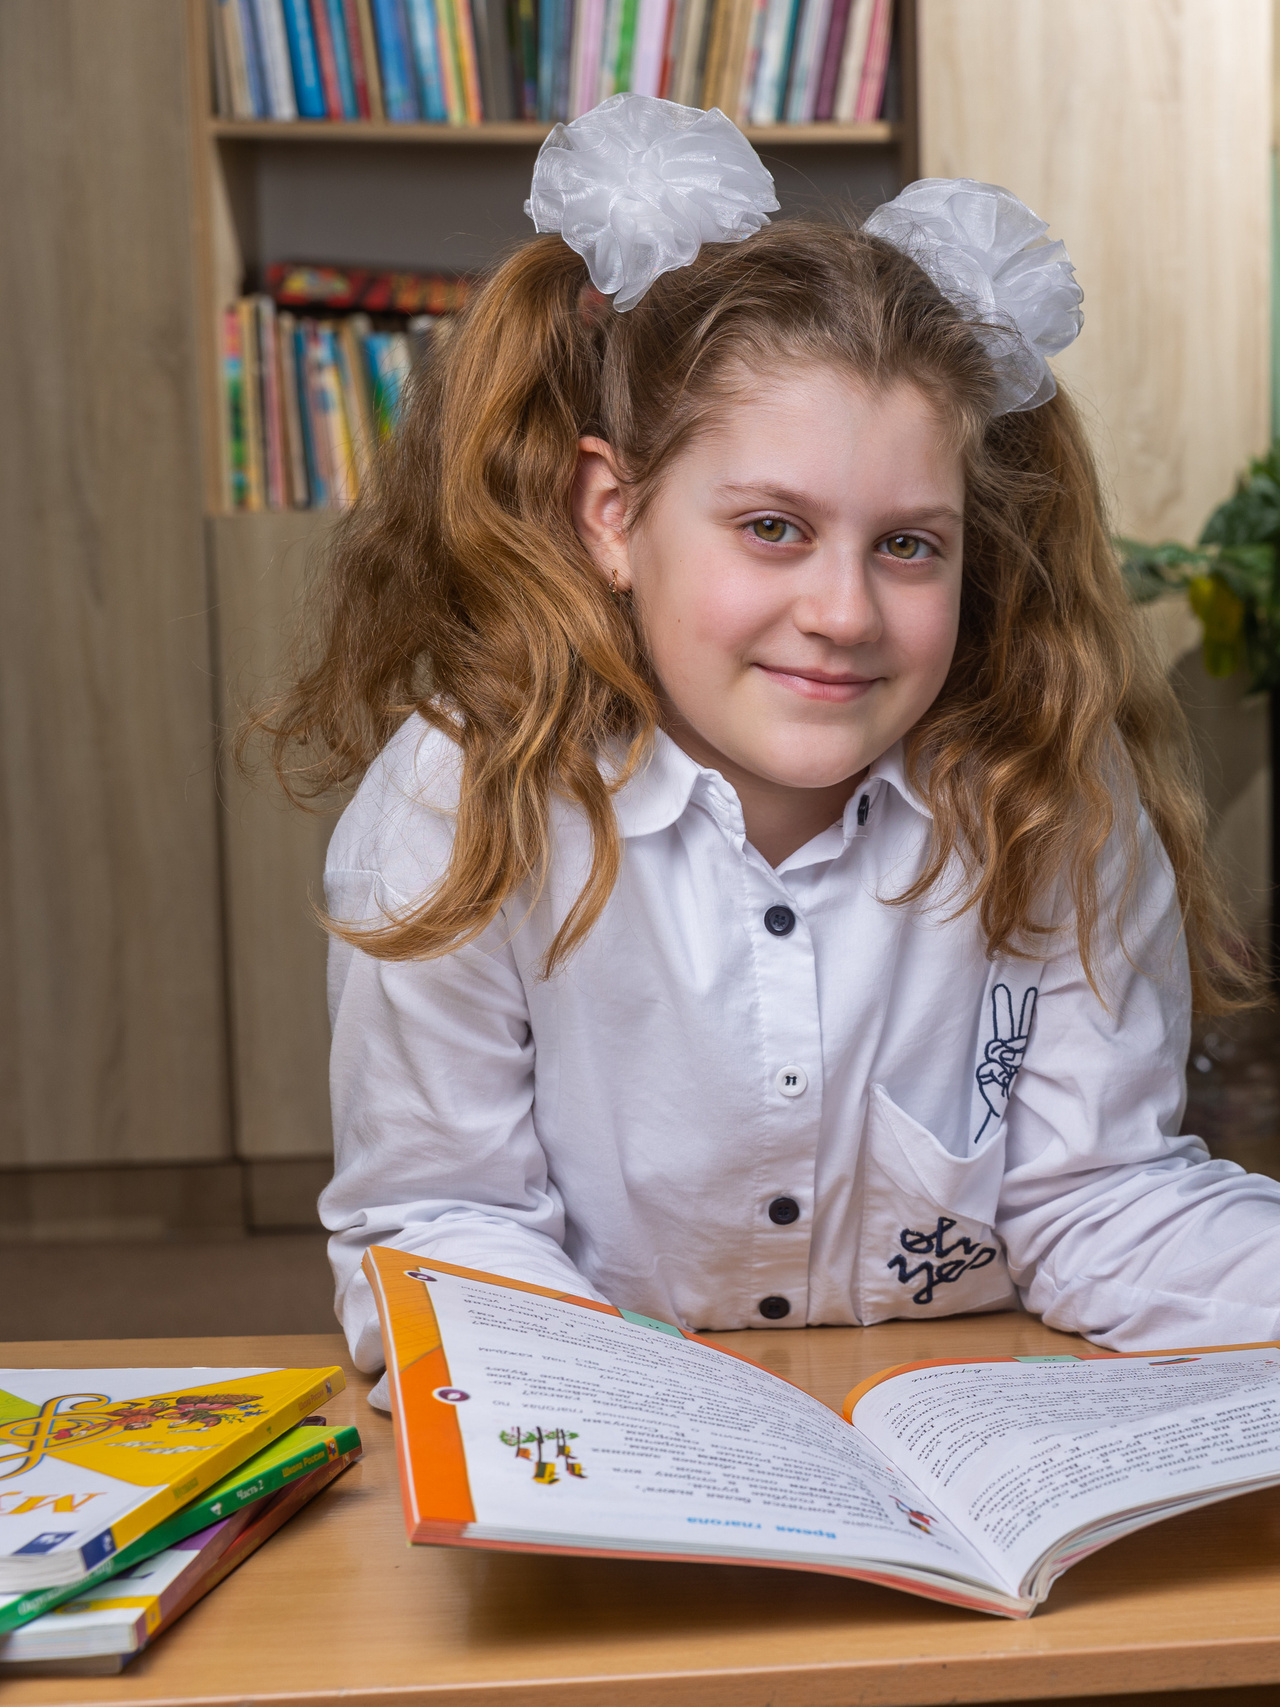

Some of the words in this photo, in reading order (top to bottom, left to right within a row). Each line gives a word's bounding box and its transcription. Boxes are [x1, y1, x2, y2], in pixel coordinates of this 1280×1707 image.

[463, 1298, 550, 1322] Драгунский
[509, 1303, 535, 1313] вам
[477, 1346, 534, 1358] каждым
[522, 1403, 583, 1414] глаголах
[1215, 1399, 1277, 1418] каждым
[1133, 1422, 1181, 1440] шагом
[1153, 1411, 1251, 1441] переливаться
[1213, 1424, 1231, 1432] на
[1157, 1430, 1204, 1446] овраг,
[1201, 1432, 1229, 1443] как
[1120, 1446, 1147, 1458] как
[1126, 1442, 1190, 1464] молодая
[1183, 1438, 1234, 1455] шумел
[1219, 1438, 1269, 1453] ветки,
[281, 1457, 304, 1479] Школа
[302, 1450, 326, 1467] России
[236, 1484, 259, 1501] Часть
[258, 1479, 265, 1491] 2
[686, 1517, 762, 1531] глагола
[776, 1525, 837, 1540] Время
